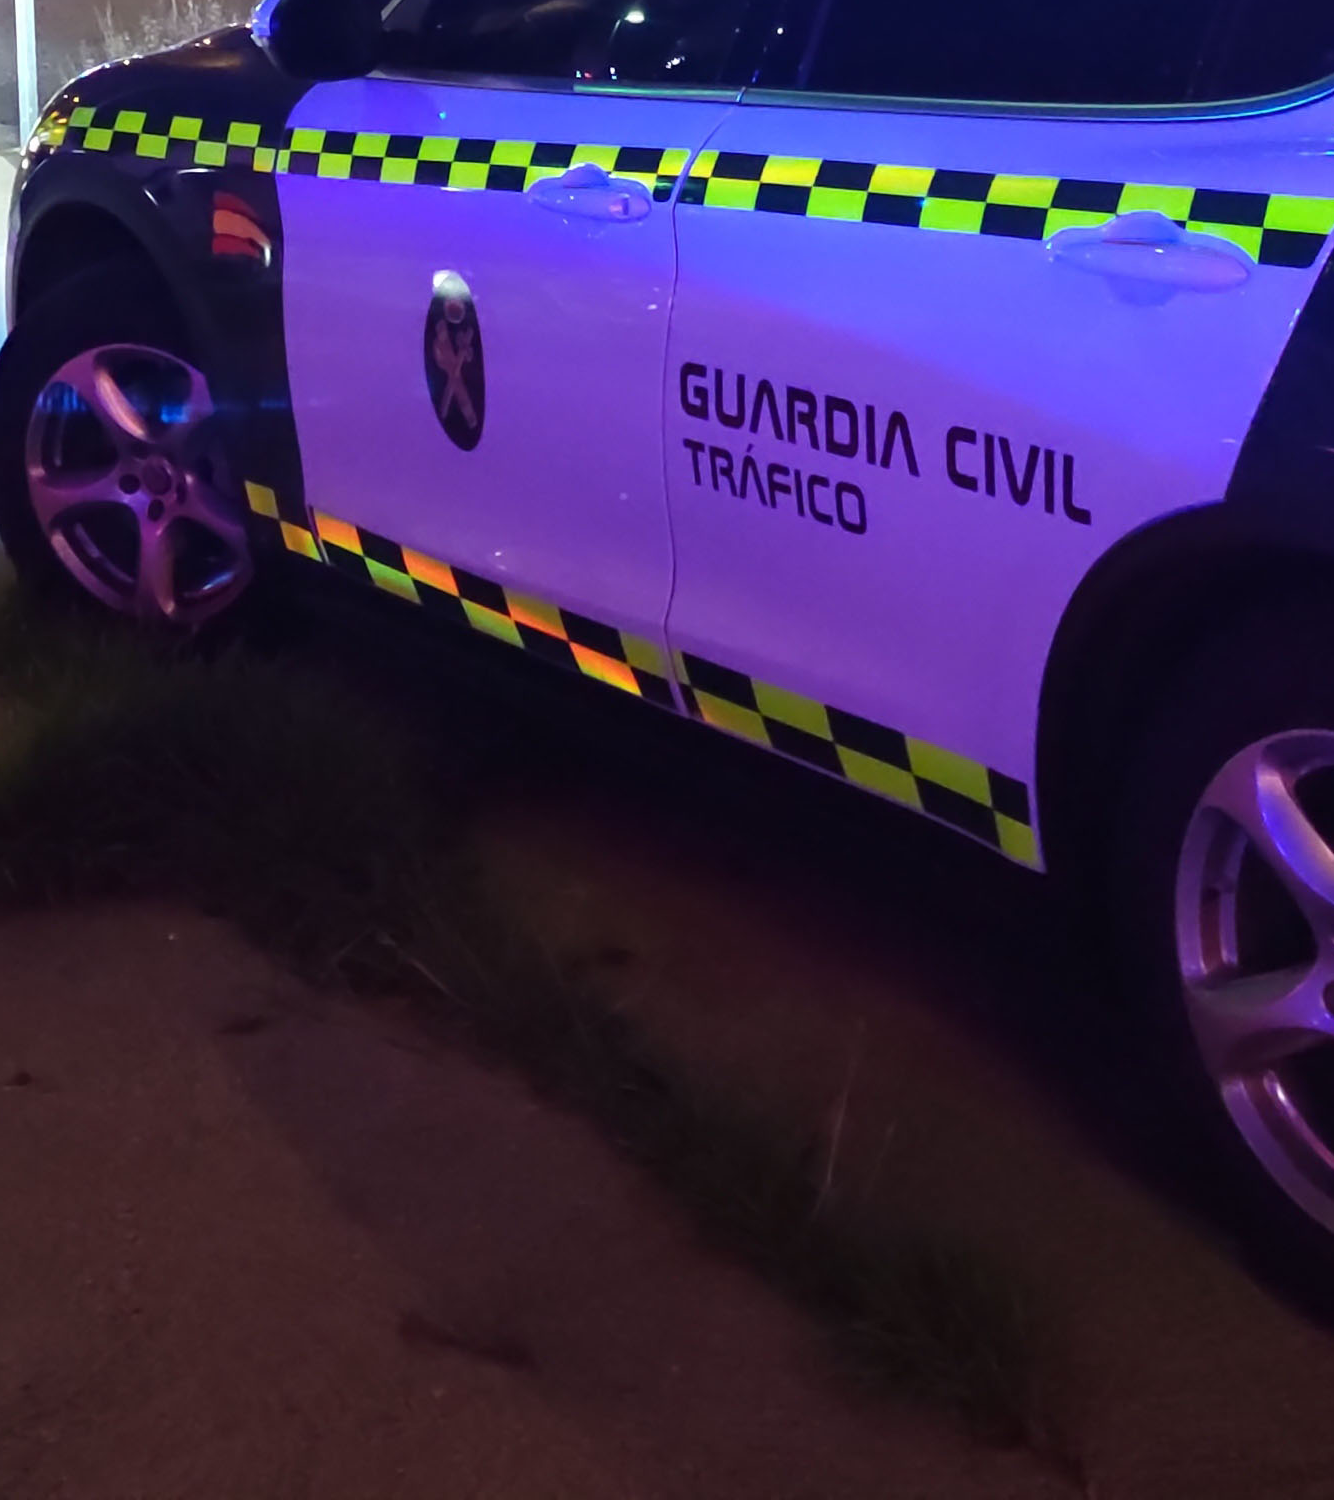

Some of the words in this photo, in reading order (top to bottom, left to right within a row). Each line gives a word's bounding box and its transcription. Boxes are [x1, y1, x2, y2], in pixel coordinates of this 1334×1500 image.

[679, 362, 920, 478] GUARDIA
[946, 426, 1092, 526] CIVIL
[682, 438, 867, 535] TRÁFICO
